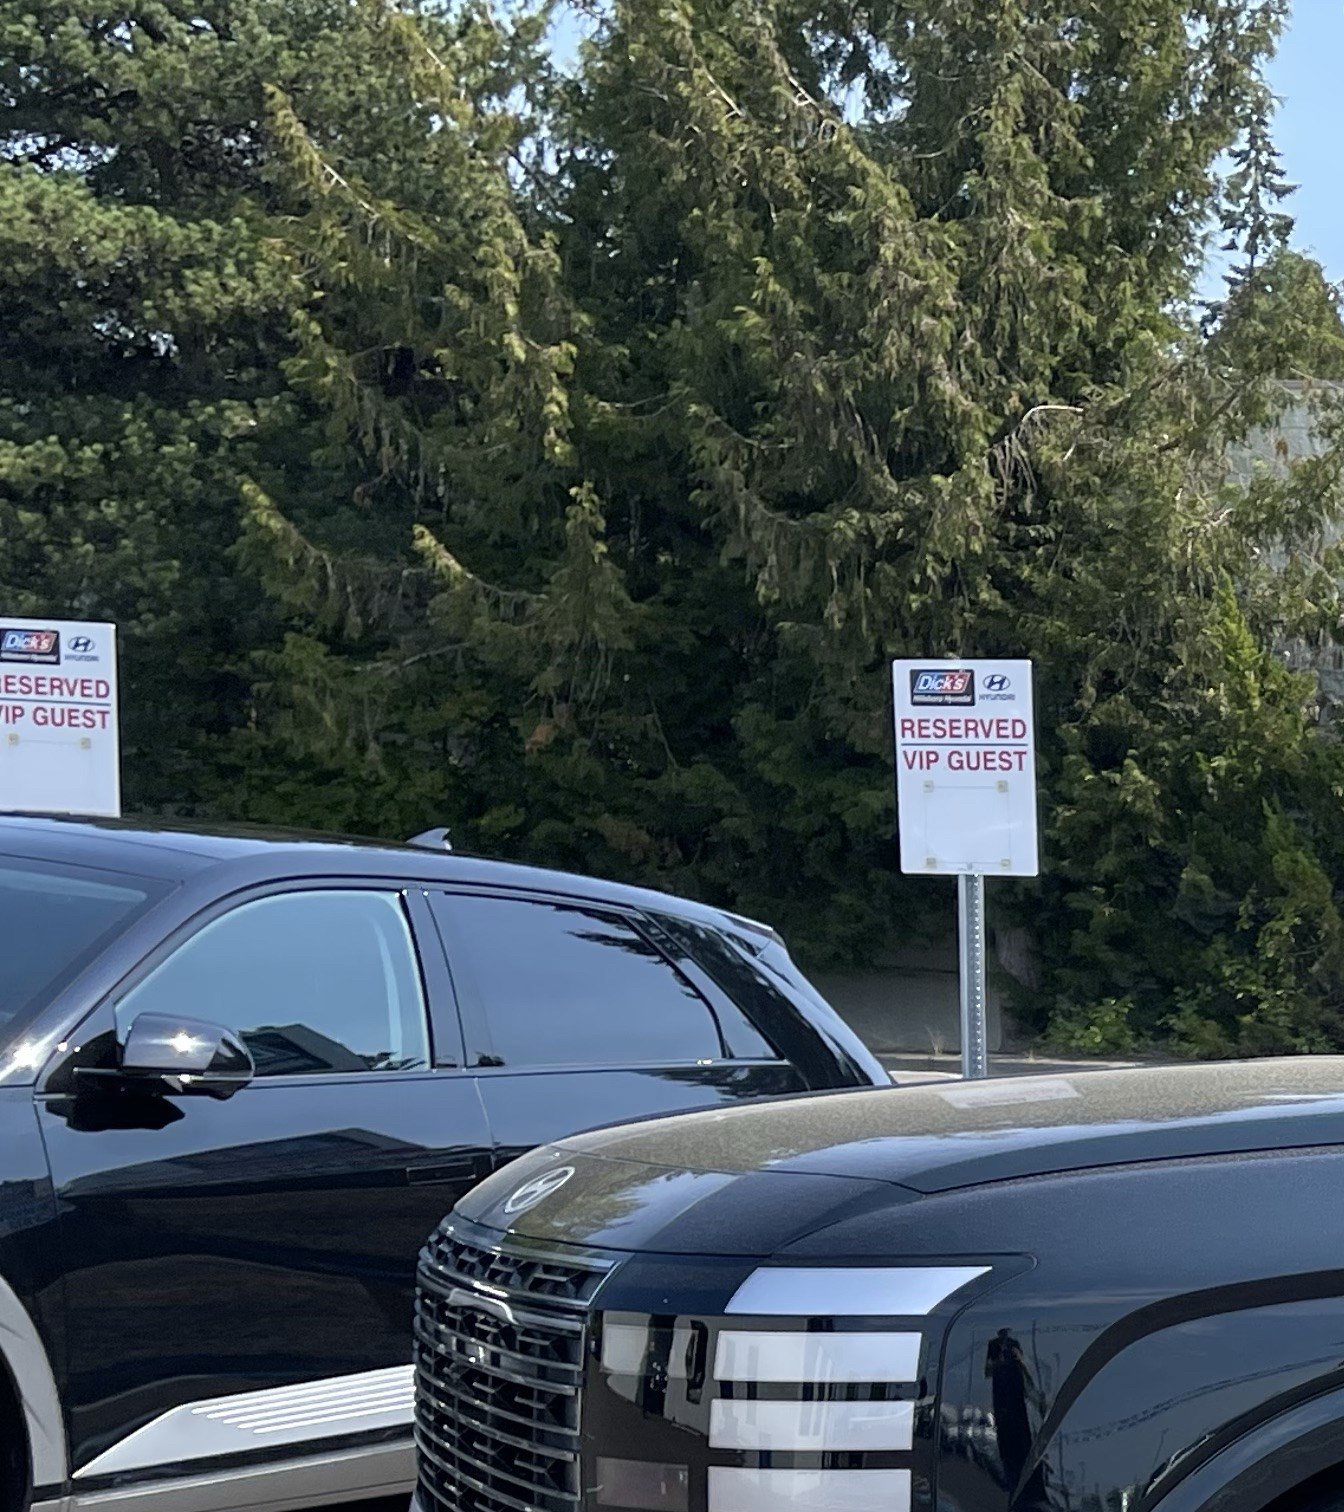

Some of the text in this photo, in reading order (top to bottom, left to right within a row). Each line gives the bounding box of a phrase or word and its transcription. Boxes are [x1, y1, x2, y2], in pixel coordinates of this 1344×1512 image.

[0, 675, 110, 699] ESERVED
[33, 706, 110, 729] GUEST
[900, 718, 1027, 739] RESERVED
[903, 750, 1027, 771] VIP GUEST
